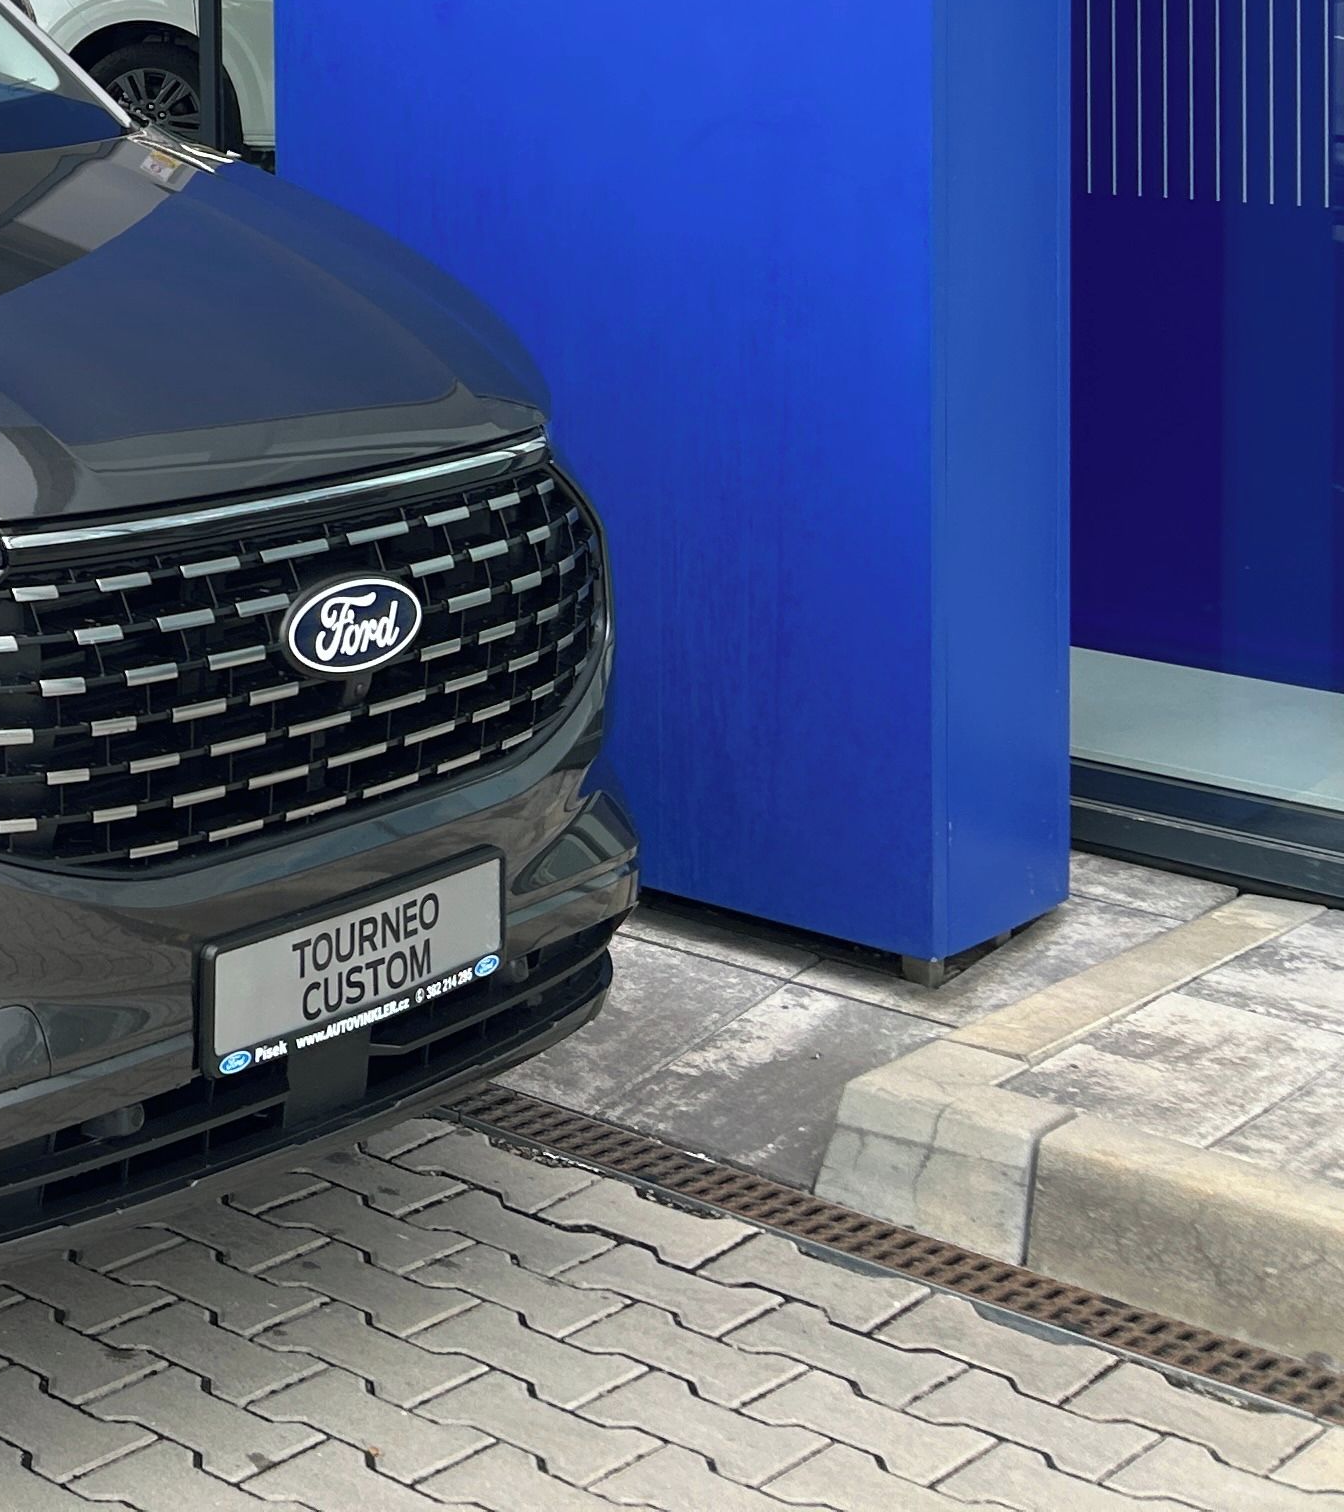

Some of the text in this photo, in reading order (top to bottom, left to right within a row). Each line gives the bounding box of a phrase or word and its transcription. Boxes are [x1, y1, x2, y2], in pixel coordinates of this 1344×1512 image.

[315, 591, 401, 662] Ford
[292, 892, 440, 979] TOURNEO
[301, 938, 433, 1022] CUSTOM
